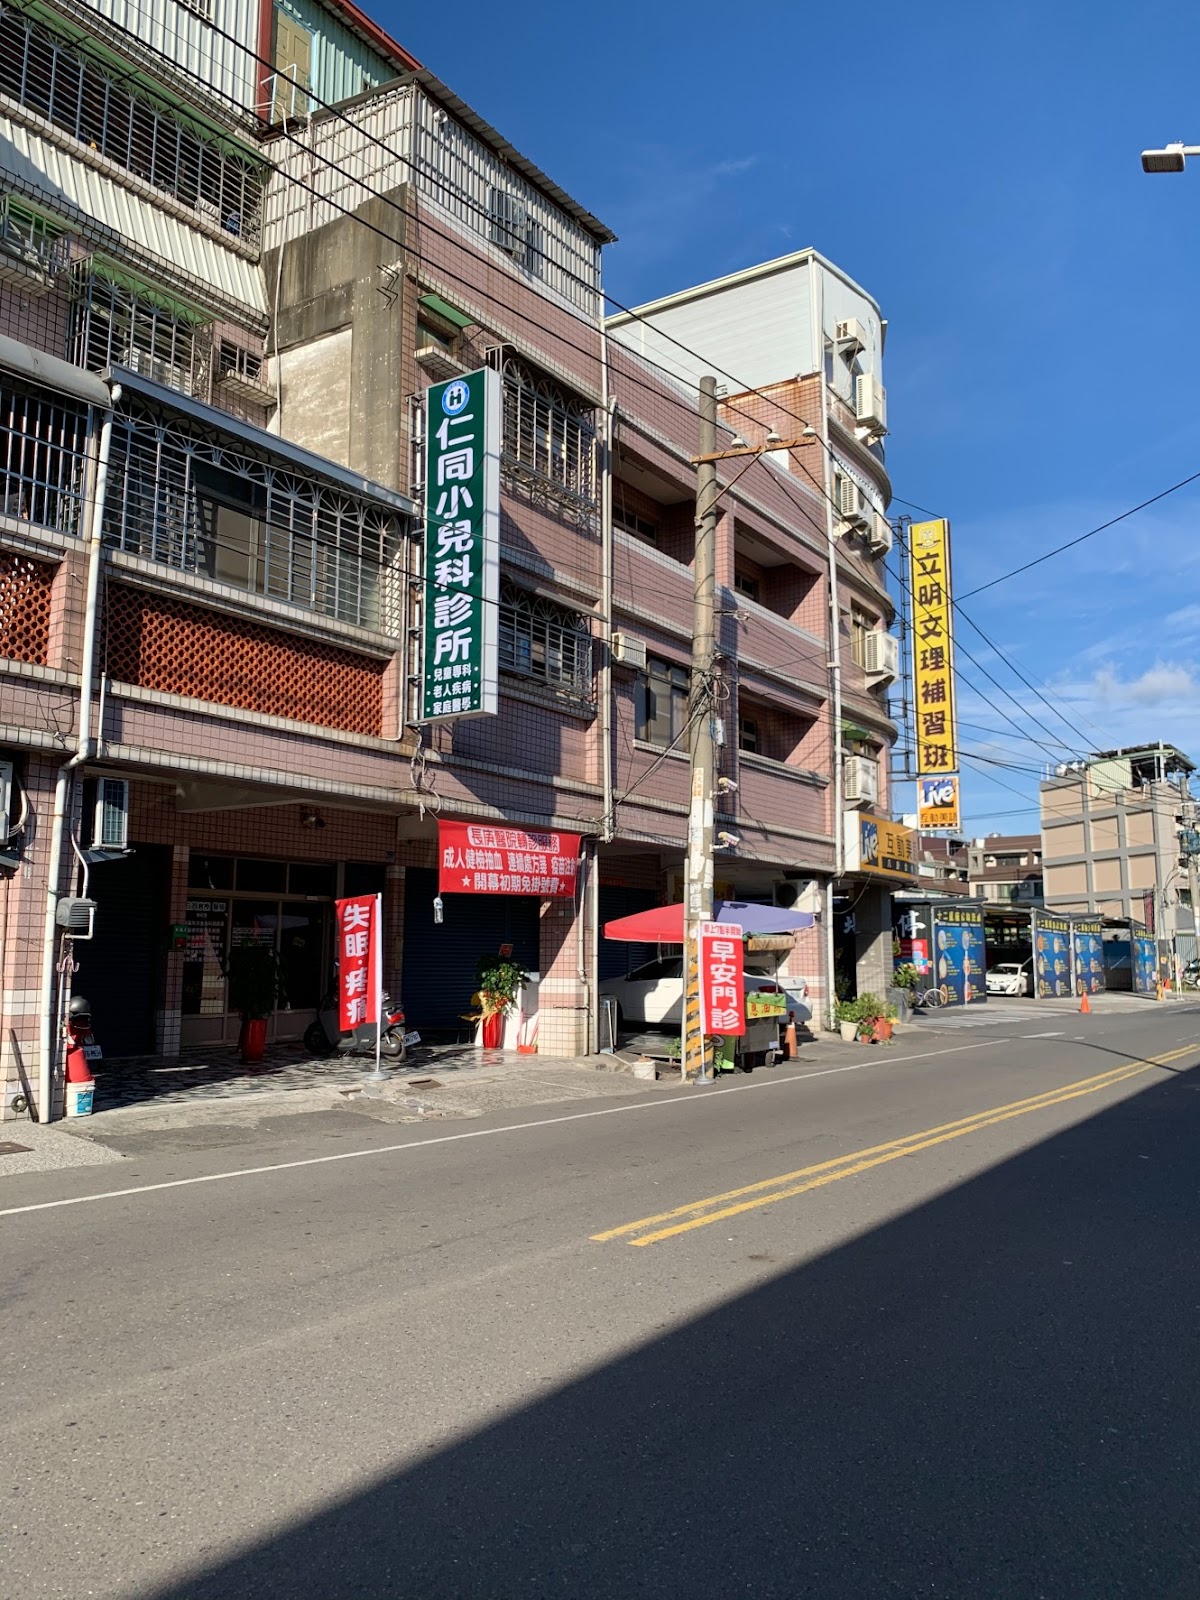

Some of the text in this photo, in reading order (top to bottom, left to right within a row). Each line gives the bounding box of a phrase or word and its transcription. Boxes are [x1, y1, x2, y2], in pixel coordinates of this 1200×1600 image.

[435, 413, 474, 665] 仁同小兒科診所
[917, 552, 948, 767] 立明文理補習班
[920, 780, 956, 807] Live
[920, 811, 958, 822] 互動美語
[710, 941, 740, 1030] 早安門診
